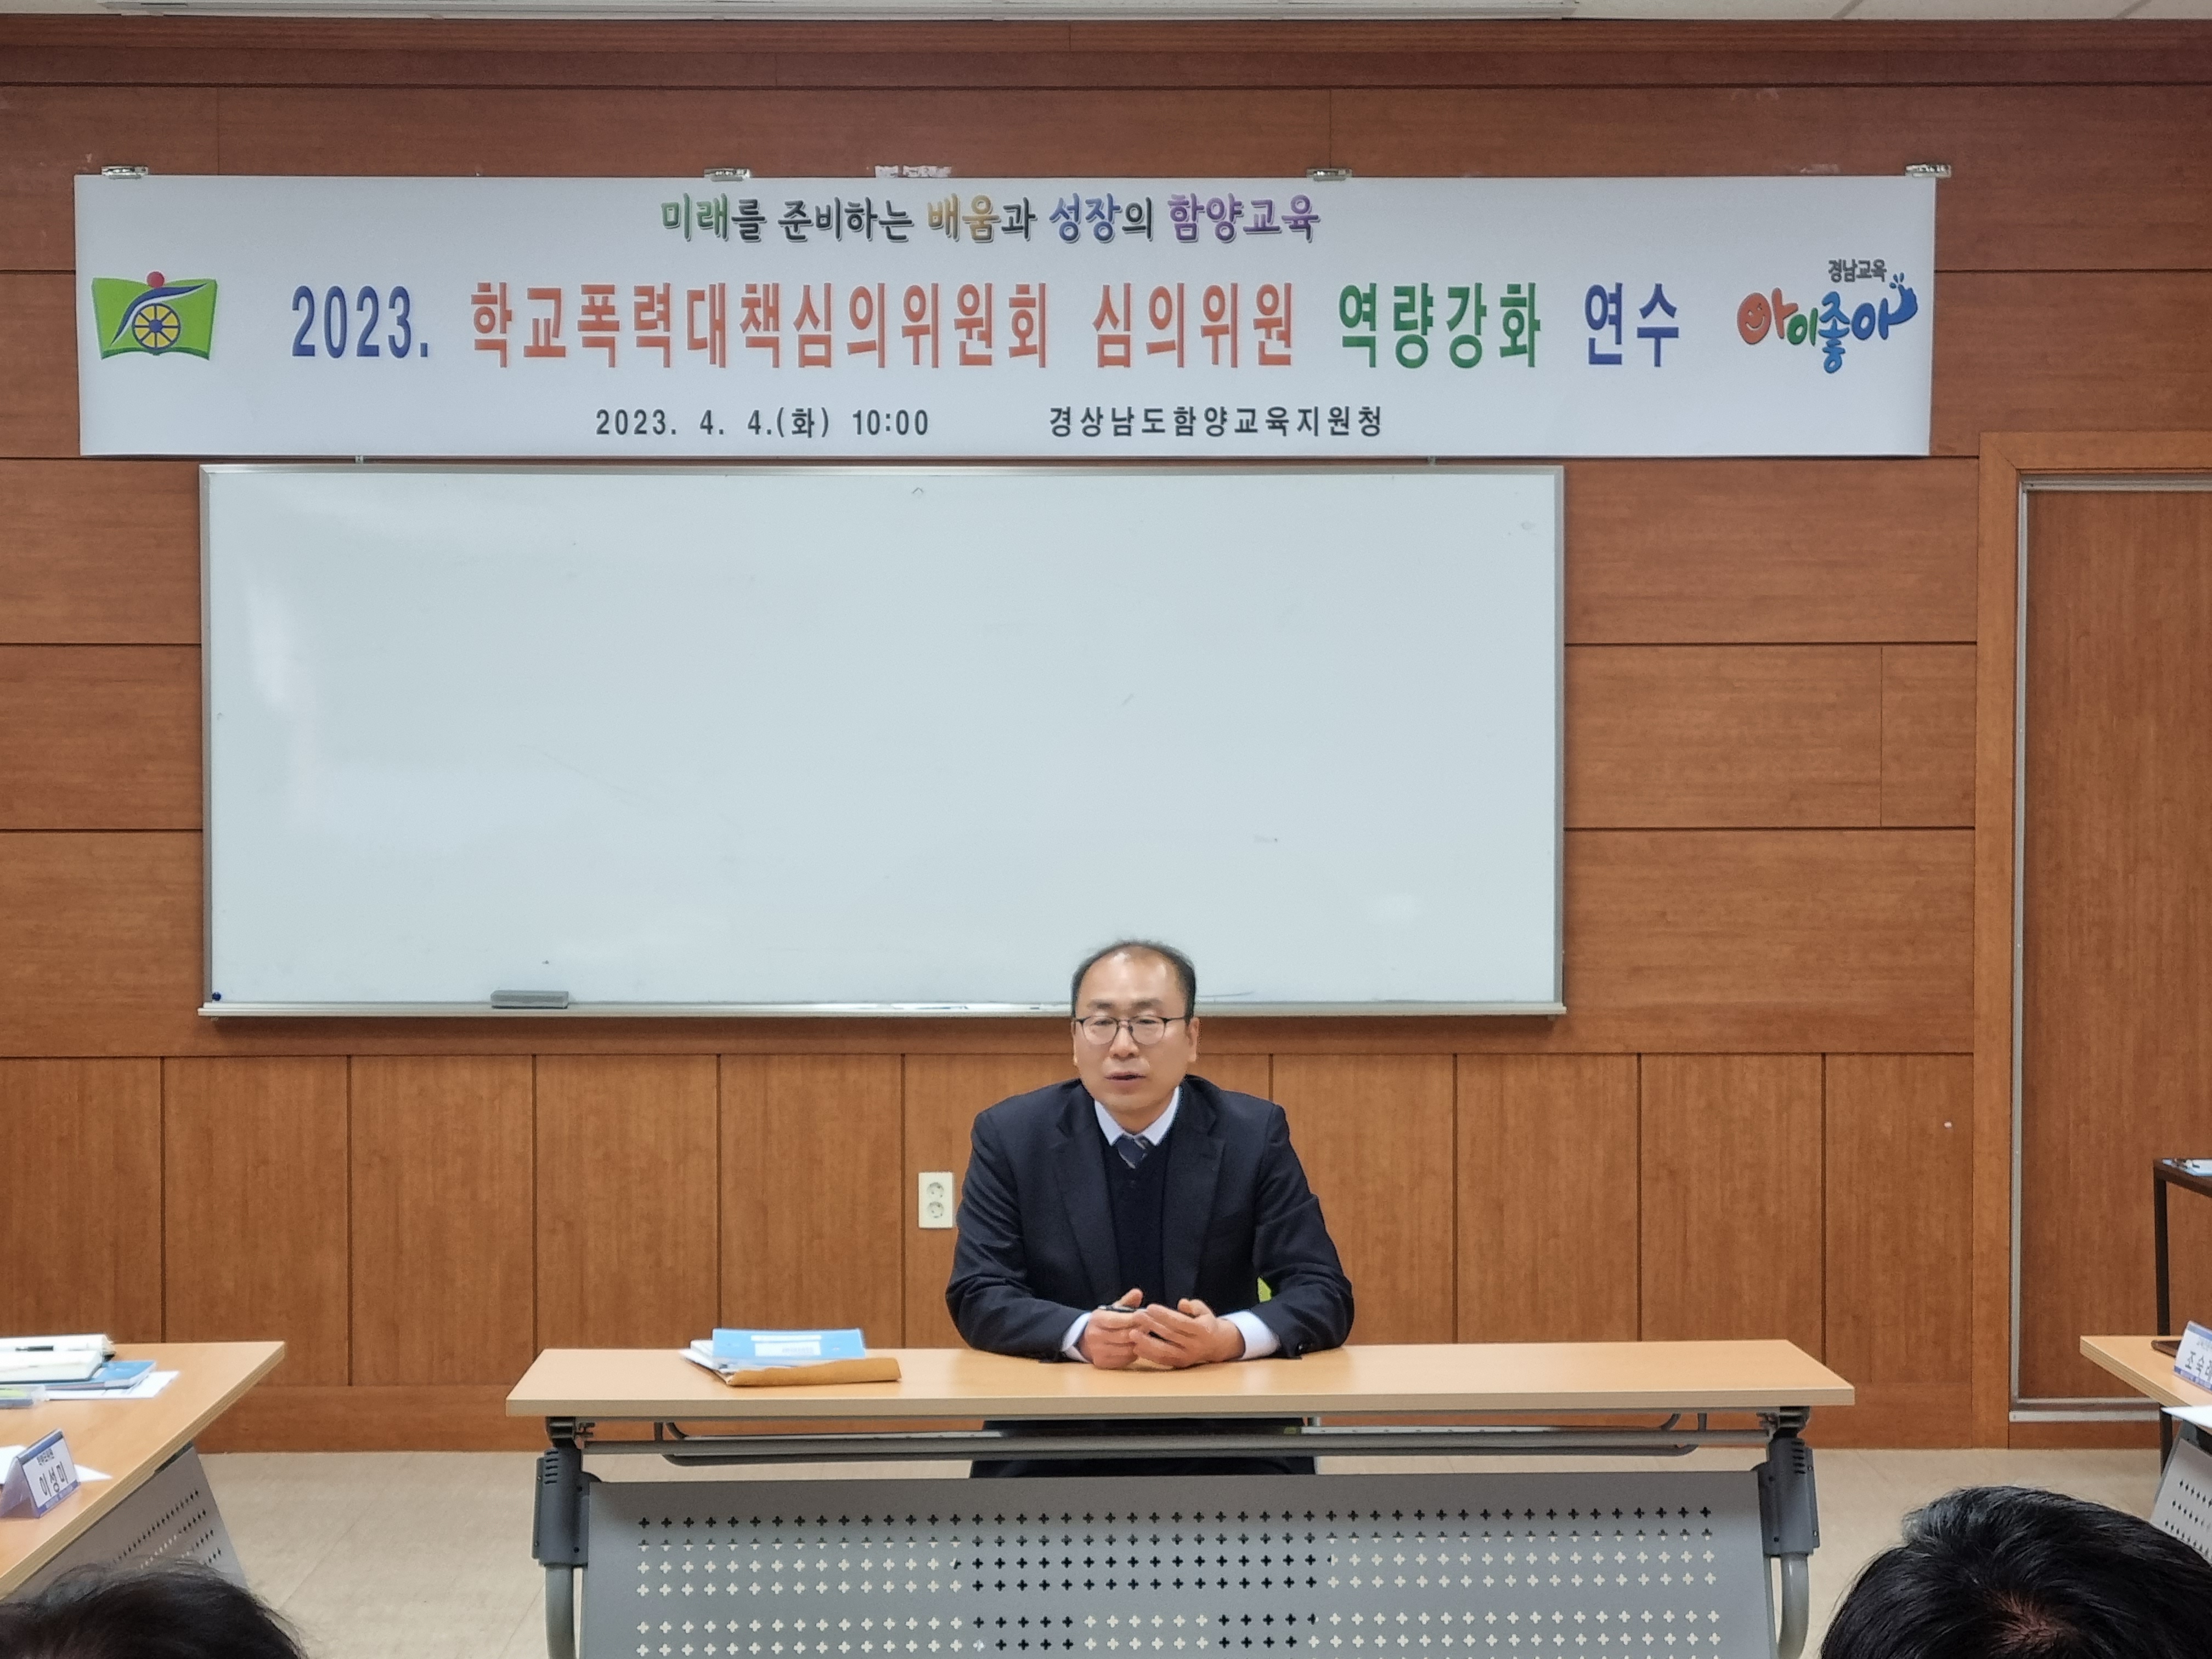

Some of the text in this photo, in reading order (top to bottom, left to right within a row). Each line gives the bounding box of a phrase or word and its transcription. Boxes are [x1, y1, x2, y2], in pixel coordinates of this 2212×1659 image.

[661, 193, 1321, 243] 미래를 준비하는 배움과 성장의 함양교육
[1828, 258, 1887, 283] 경남교육
[292, 282, 1679, 369] 2023. 학교폭력대책심의위원회 심의위원 역량강화 연수
[1737, 284, 1918, 374] 아이좋아
[596, 407, 928, 438] 2023. 4. 4.(화) 10:00
[1050, 406, 1380, 437] 경상남도함양교육지원청
